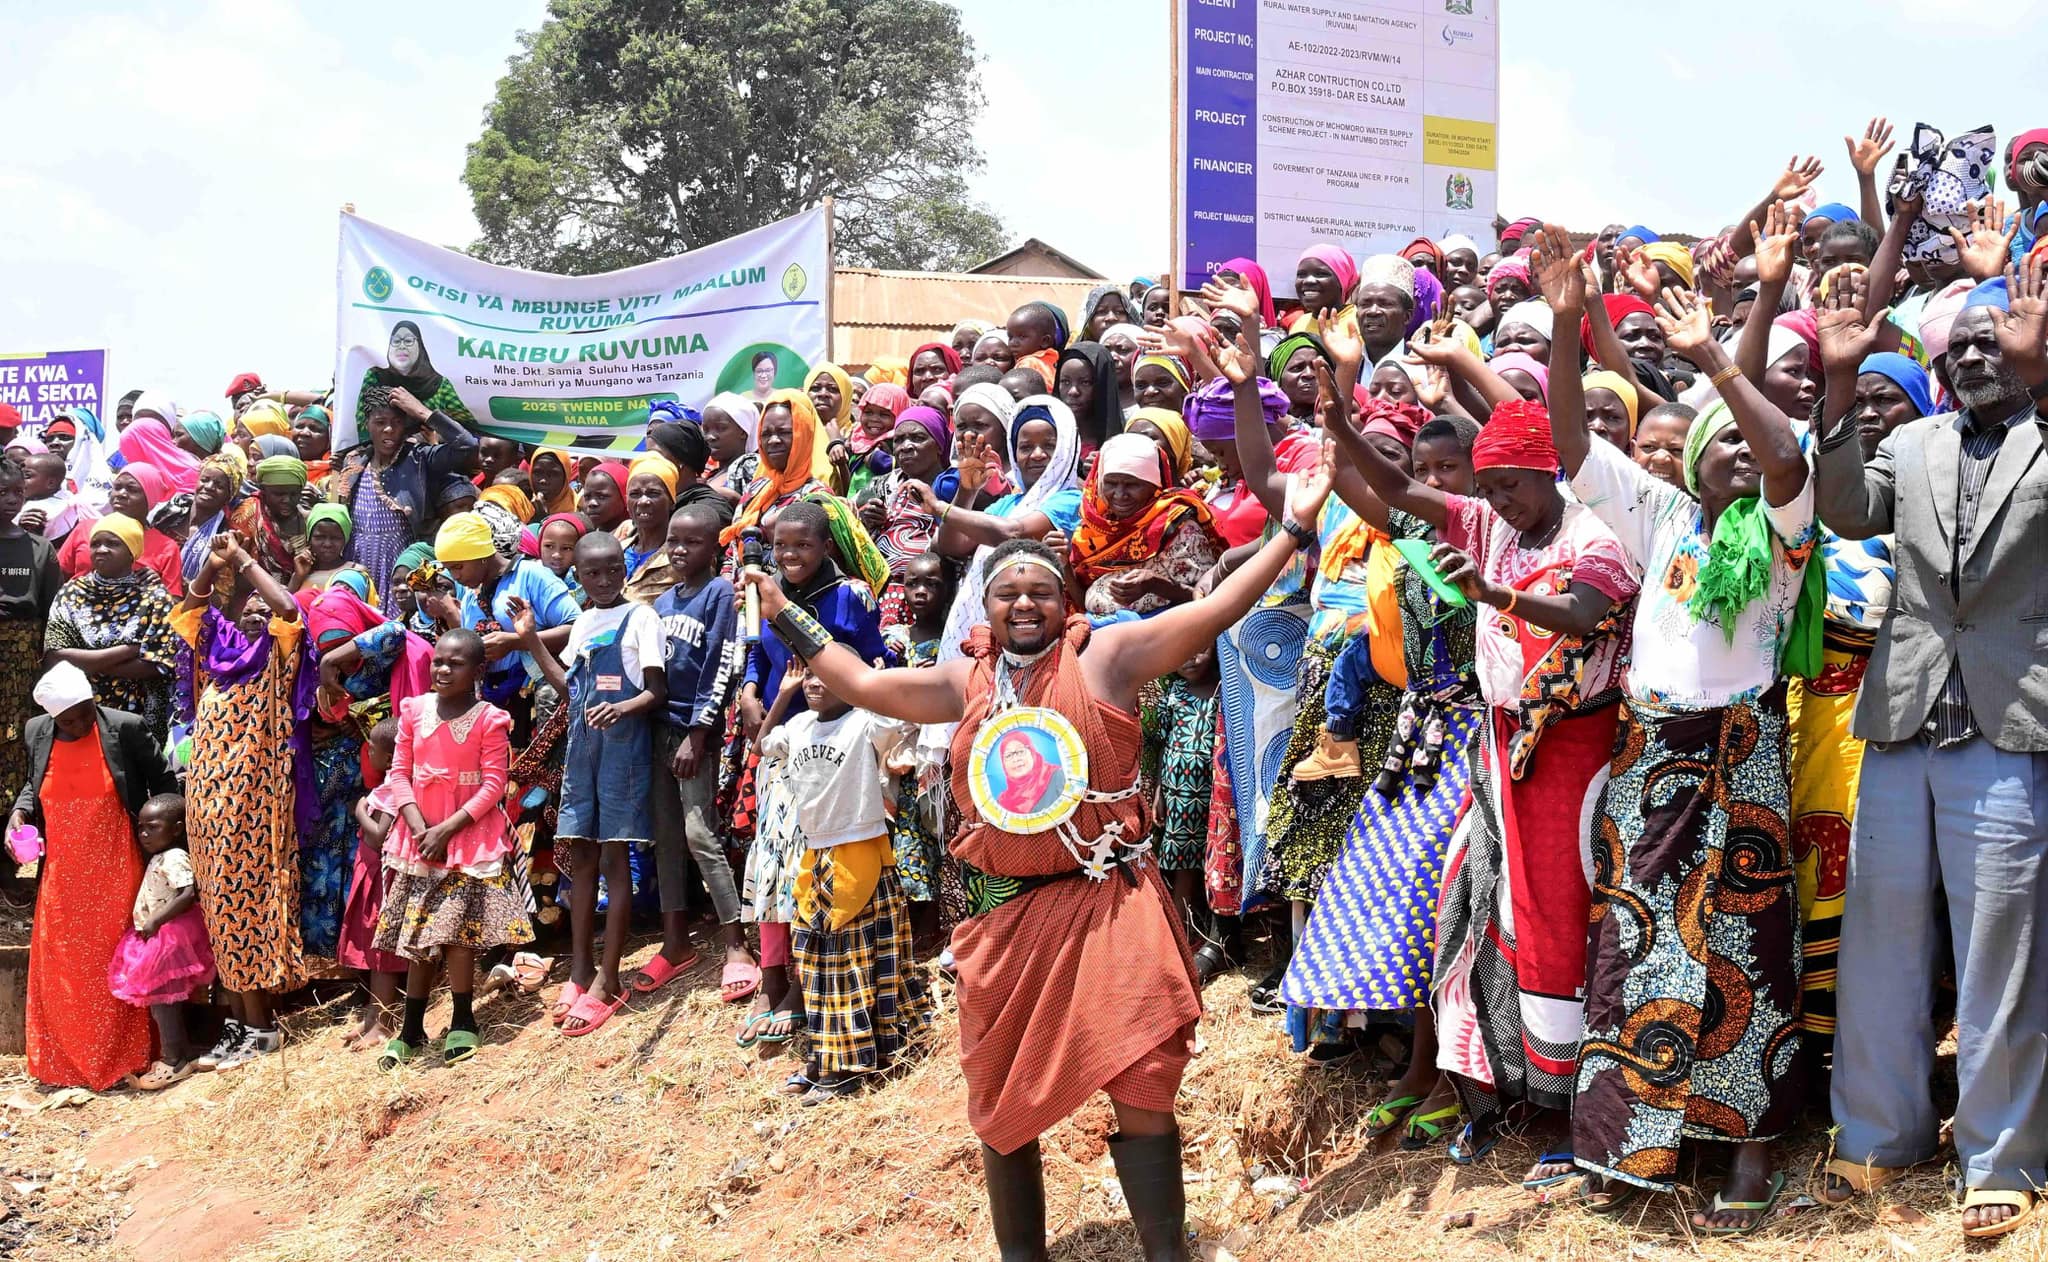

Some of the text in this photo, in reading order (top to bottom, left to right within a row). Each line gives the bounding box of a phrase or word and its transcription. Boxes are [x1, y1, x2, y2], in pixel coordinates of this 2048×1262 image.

[1263, 0, 1417, 30] RURAL WATER SUPPLY AND SANITATION AGENCY
[1325, 20, 1358, 32] (RUVUMA)
[1195, 28, 1236, 44] PROJECT
[1288, 41, 1401, 65] AE-102/2022-2023/RVM/W/14
[1196, 66, 1254, 81] MAIN CONTRACTOR
[1276, 69, 1306, 81] AZHAR
[1308, 73, 1371, 89] CONTRUCTION
[1337, 90, 1355, 101] DAR
[1357, 92, 1368, 103] ES
[1370, 94, 1406, 107] SALAAM
[1195, 109, 1247, 126] PROJECT
[1262, 114, 1413, 139] CONSTRUCTION OF MCHOMORO WATER SUPPLY
[1268, 125, 1296, 135] SCHEME
[1298, 129, 1328, 139] PROJECT
[1333, 133, 1340, 141] IN
[1341, 134, 1378, 145] NAMTUMBO
[1379, 138, 1408, 148] DISTRICT
[1194, 158, 1253, 175] FINANCIER
[1273, 163, 1314, 175] GOVERMENT
[1316, 168, 1324, 176] OF
[1326, 169, 1358, 179] TANZANIA
[1390, 175, 1403, 184] FOR
[1404, 177, 1409, 185] R
[1326, 179, 1360, 189] PROGRAM
[1194, 210, 1255, 224] PROJECT MANAGER
[1264, 212, 1294, 222] DISTRICT
[1354, 220, 1377, 230] WATER
[1378, 222, 1402, 232] SUPPLY
[1403, 225, 1416, 233] AND
[1345, 229, 1373, 239] AGENCY
[407, 266, 766, 314] OFISI YA MBUNGE VITI MAALUM
[539, 311, 635, 330] RUVUMA
[457, 333, 709, 364] KARIBU RUVUMA
[25, 365, 69, 383] KWA
[494, 360, 673, 376] Mhe. Dkt. Samia Suluhu Hassan
[465, 370, 704, 389] Rais wa Jamhuri ya Muungano wa Tanzania
[0, 383, 97, 403] HA SEKTA
[522, 399, 649, 412] 2025 TWENDE NA
[564, 415, 608, 425] MAMA
[669, 614, 705, 648] STATE
[710, 638, 736, 706] NITTANY
[793, 744, 846, 772] FOREVER
